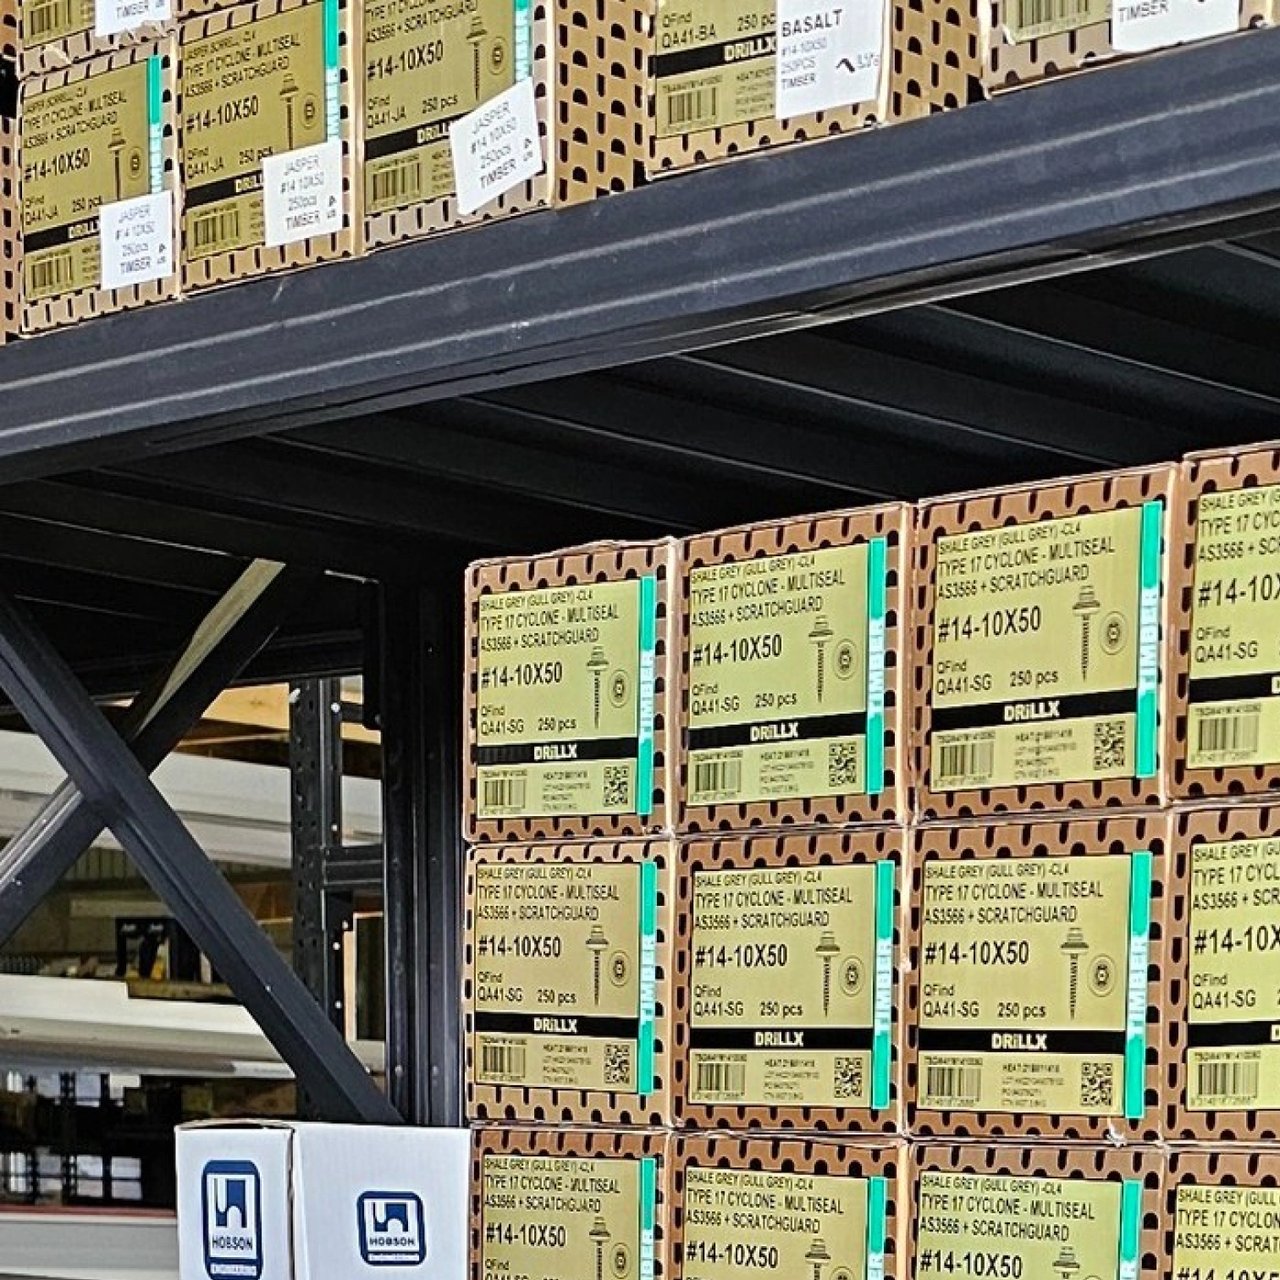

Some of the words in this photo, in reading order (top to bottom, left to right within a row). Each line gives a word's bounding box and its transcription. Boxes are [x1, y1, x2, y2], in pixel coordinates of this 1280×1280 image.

[662, 24, 717, 48] QA41-BA
[737, 14, 758, 32] 250
[761, 12, 776, 29] pc
[782, 9, 843, 38] BASALT
[368, 40, 444, 80] #14-10X50
[781, 73, 817, 90] TIMBER
[186, 95, 259, 133] #14-10X50
[440, 95, 459, 111] pcs
[479, 158, 517, 189] TIMBER
[285, 211, 321, 230] TIMBER
[120, 256, 151, 275] TIMBER
[938, 604, 1042, 643] #14-10X50
[692, 632, 782, 668] #14-10X50
[1195, 641, 1259, 665] QA41-SG
[481, 660, 562, 689] #14-10X50
[479, 934, 561, 958] #14-10X50
[696, 943, 787, 969] #14-10X50
[925, 940, 1030, 966] #14-10X50
[694, 1001, 743, 1017] QA41-SG
[212, 1236, 252, 1250] HOBSON
[370, 1237, 415, 1247] HOBSON
[486, 1222, 566, 1248] #14-10X50
[686, 1239, 778, 1269] #14-10X50
[921, 1247, 1023, 1280] #14-10X50
